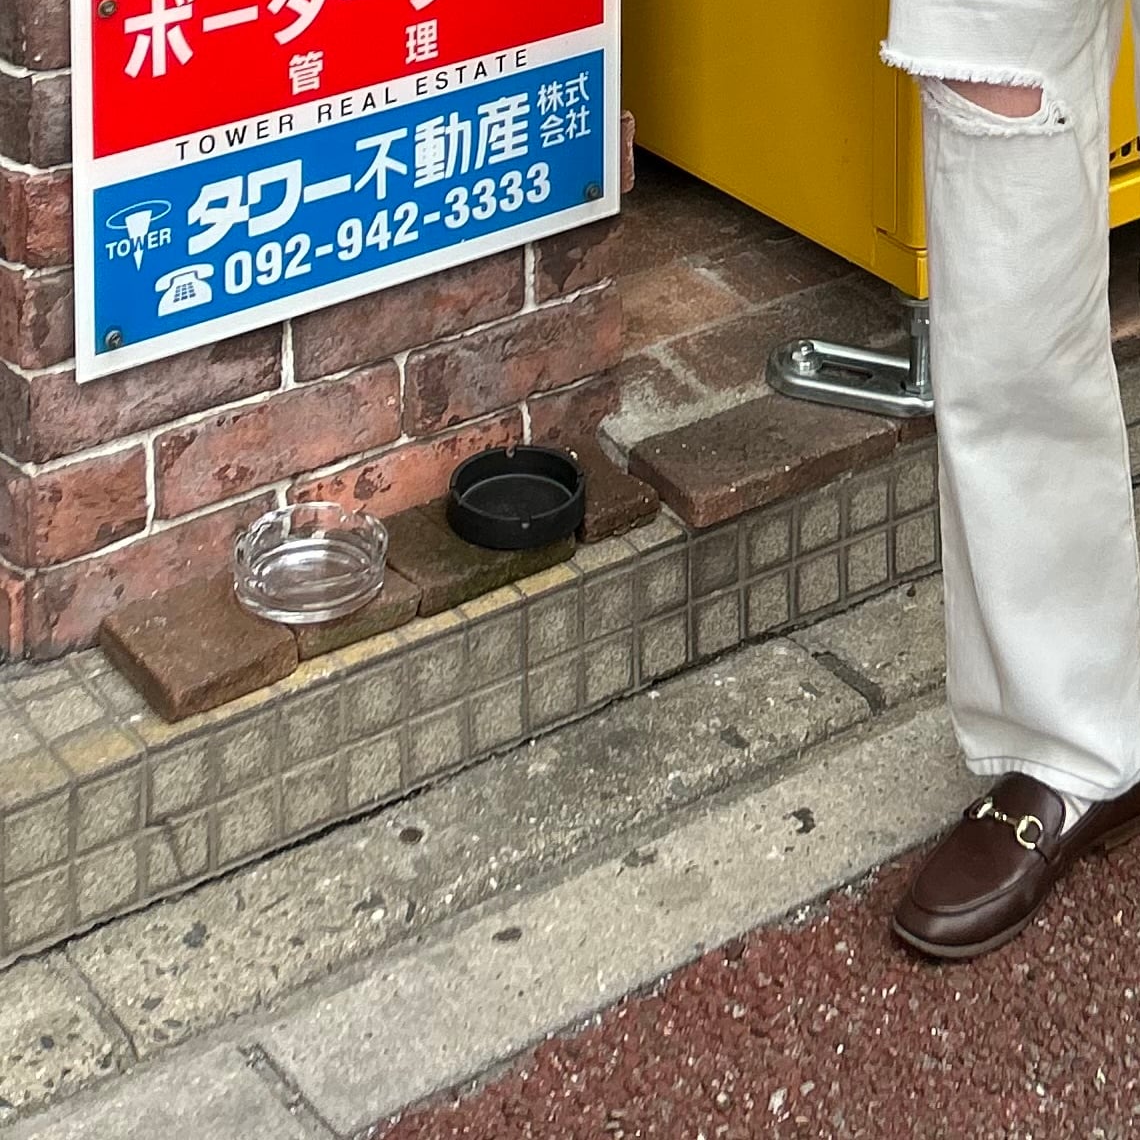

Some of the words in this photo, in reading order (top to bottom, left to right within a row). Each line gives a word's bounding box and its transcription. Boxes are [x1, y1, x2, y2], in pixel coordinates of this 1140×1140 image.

[176, 114, 294, 160] TOWER
[318, 87, 397, 123] REAL
[416, 49, 527, 95] ESTATE
[187, 92, 530, 255] タワー不動産
[225, 162, 551, 294] 092-942-3333
[105, 227, 172, 262] TOWER
